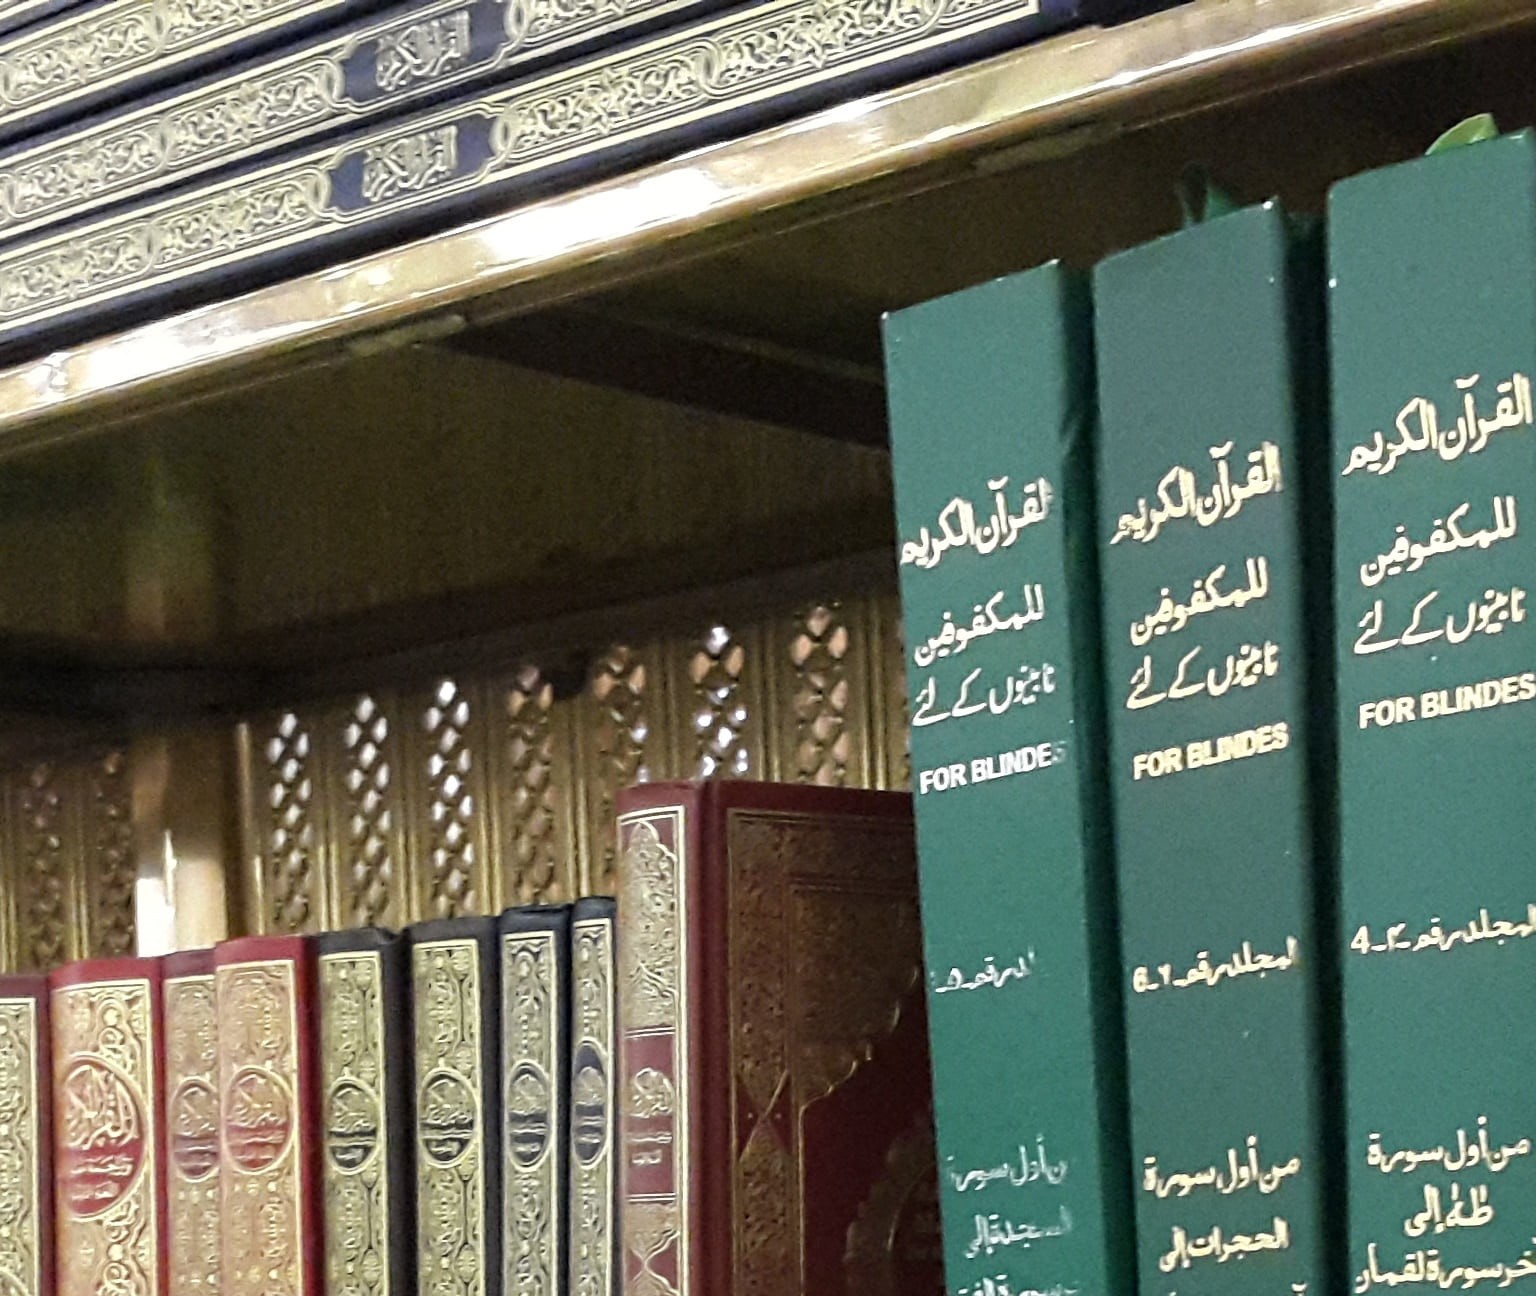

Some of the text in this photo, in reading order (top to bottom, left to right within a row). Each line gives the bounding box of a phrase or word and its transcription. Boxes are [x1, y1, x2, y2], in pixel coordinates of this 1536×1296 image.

[1341, 372, 1534, 476] القرآن الكريم
[1109, 440, 1282, 545] القرآن الكريم
[899, 497, 977, 569] الكريم
[1359, 495, 1517, 587] للمكفوفين
[913, 583, 1047, 668] للمكفوفين
[1130, 556, 1270, 649] للمكفوفين
[1359, 696, 1416, 729] FOR
[919, 763, 968, 795] FOR
[1133, 721, 1290, 781] FOR BLINDES
[1215, 1135, 1261, 1194] أول
[1258, 1157, 1301, 1194] من
[1367, 1115, 1531, 1173] من أول سورة
